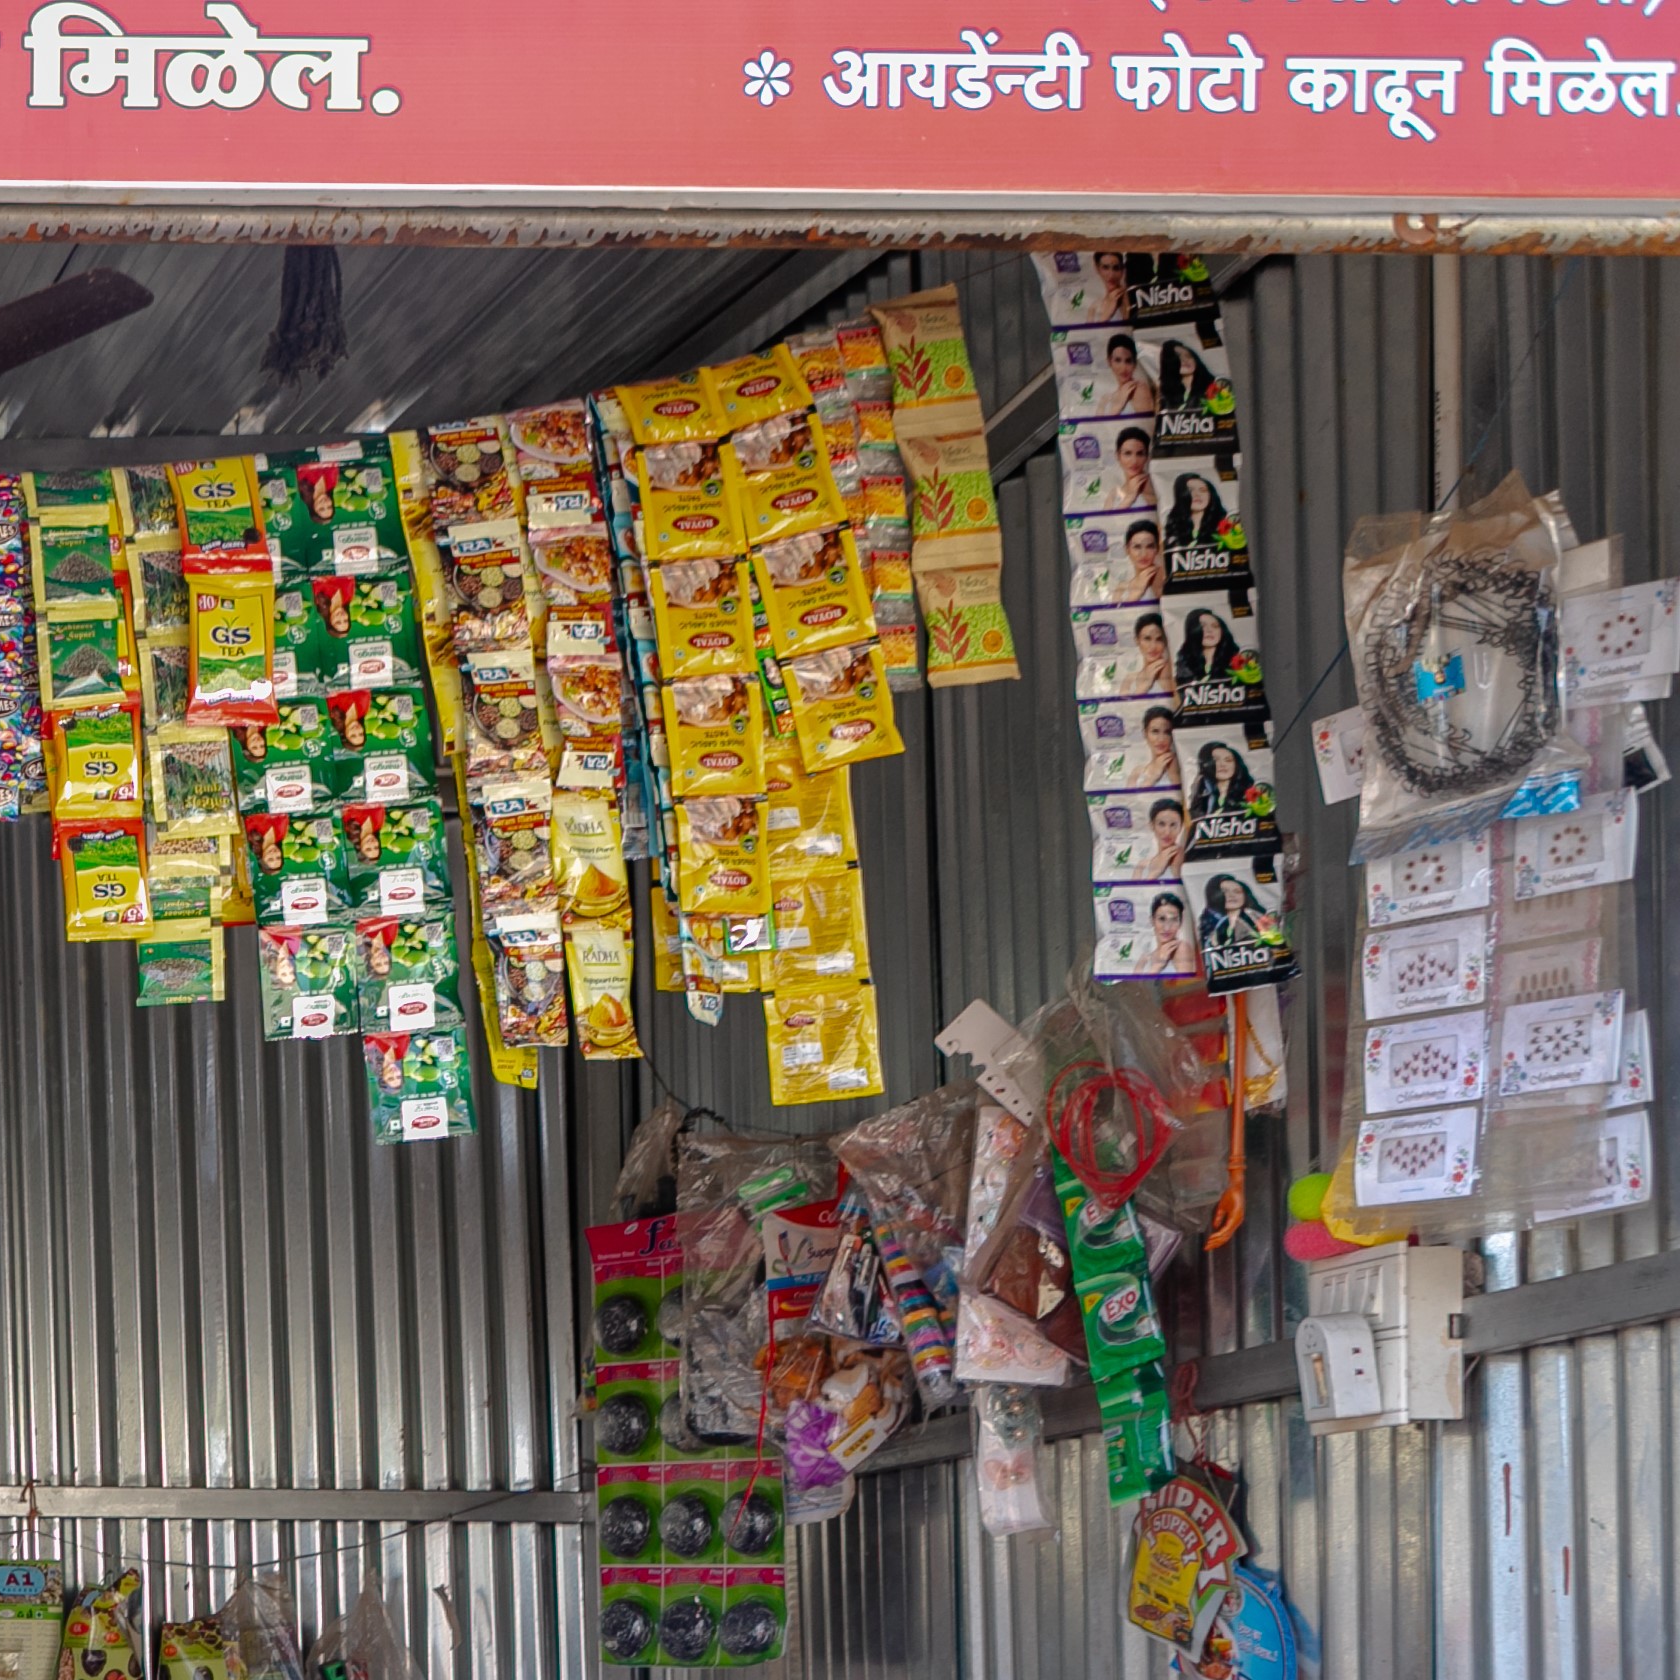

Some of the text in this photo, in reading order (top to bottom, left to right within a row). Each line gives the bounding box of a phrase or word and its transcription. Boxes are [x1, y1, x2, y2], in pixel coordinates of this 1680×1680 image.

[22, 0, 401, 116] मिळेल.
[1109, 31, 1266, 114] फोटो
[1284, 56, 1465, 143] काढून
[1483, 36, 1680, 119] मिळेल
[1135, 281, 1193, 308] Nisha
[657, 403, 695, 415] ROYAL
[1160, 411, 1215, 437] Nisha
[193, 481, 236, 499] GS
[203, 498, 233, 509] TEA
[675, 518, 714, 530] ROYAL
[459, 540, 490, 552] RA
[1171, 547, 1230, 573] Nisha
[211, 625, 252, 644] GS
[218, 645, 246, 657] TEA
[478, 668, 508, 679] RA
[84, 760, 119, 776] GS
[565, 819, 605, 834] RADHA
[582, 948, 620, 963] RADHA
[1104, 1286, 1138, 1320] EXO
[1152, 1513, 1199, 1549] SUPER
[6, 1573, 34, 1586] A1
